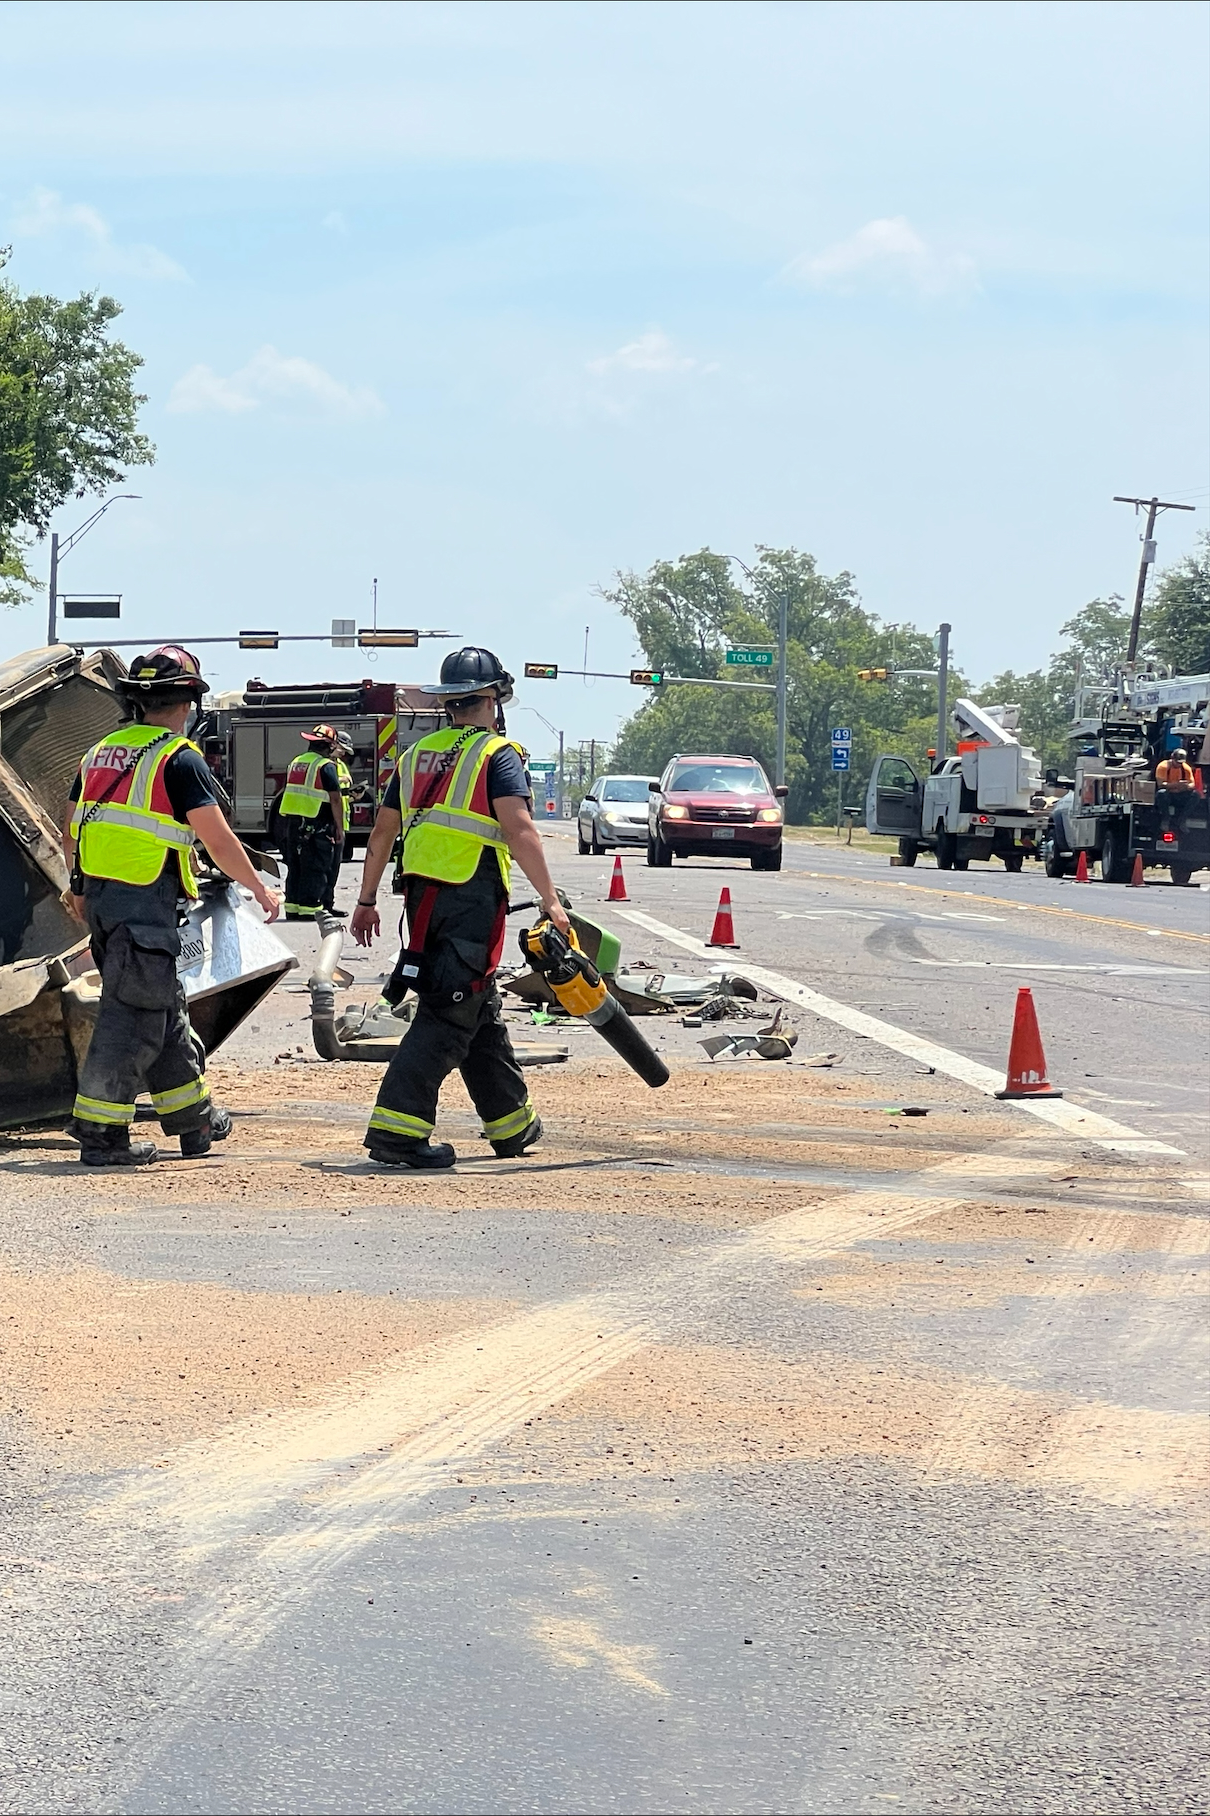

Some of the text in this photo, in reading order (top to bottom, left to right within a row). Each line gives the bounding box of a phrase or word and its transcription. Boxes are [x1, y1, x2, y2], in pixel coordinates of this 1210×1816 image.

[731, 653, 768, 663] TOLL 49
[834, 729, 849, 740] 49
[416, 749, 453, 773] FIR
